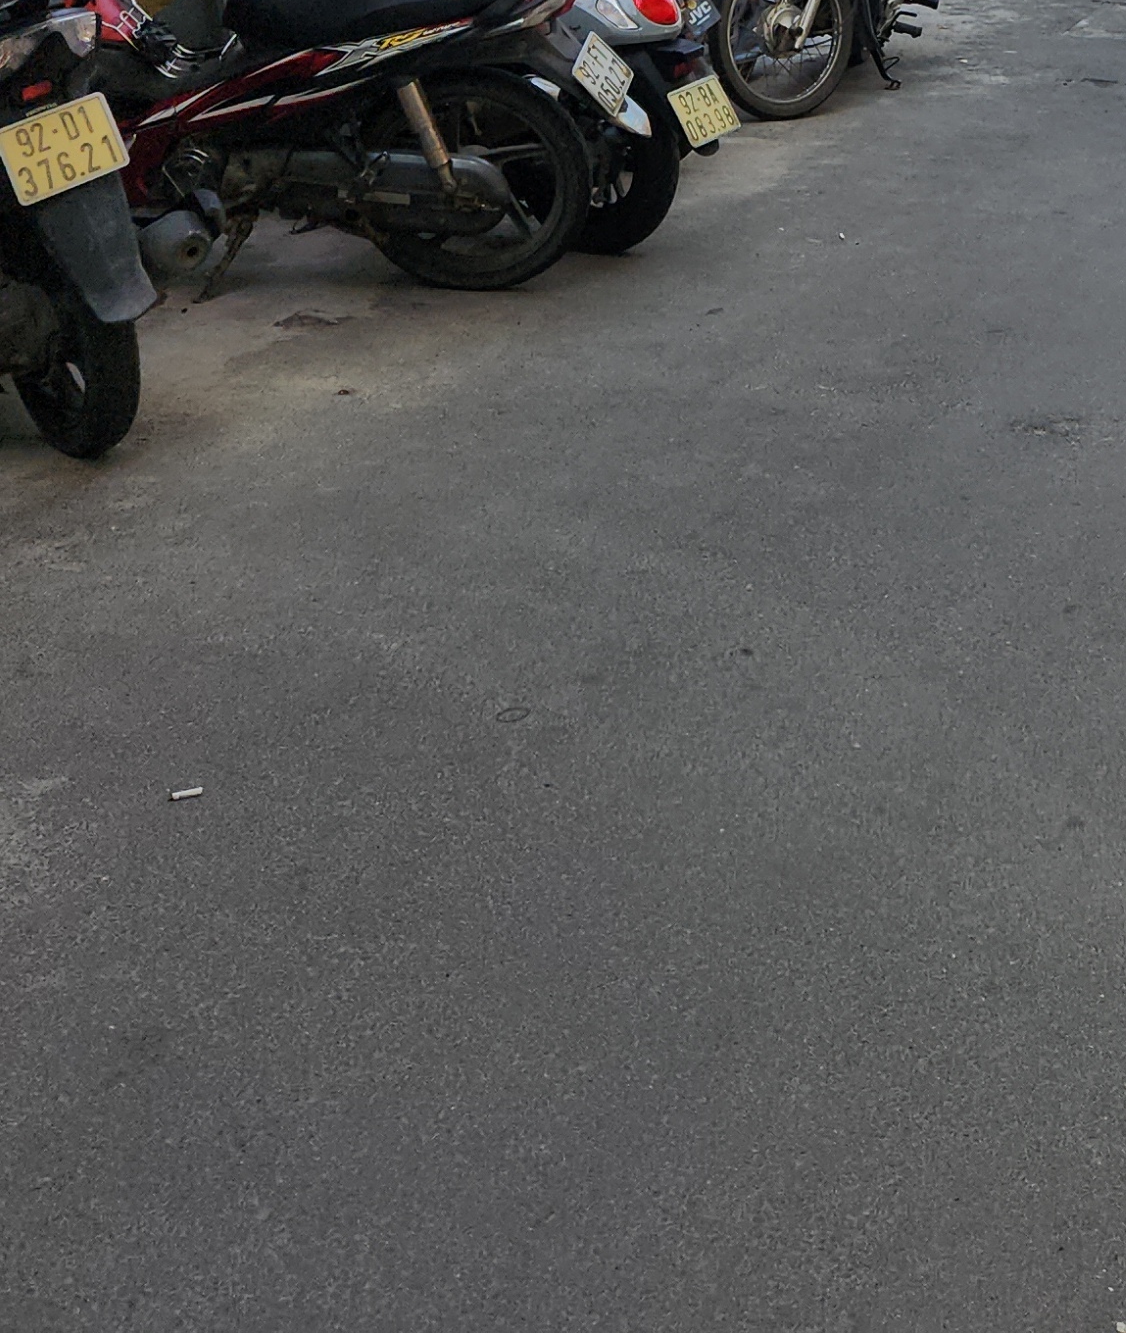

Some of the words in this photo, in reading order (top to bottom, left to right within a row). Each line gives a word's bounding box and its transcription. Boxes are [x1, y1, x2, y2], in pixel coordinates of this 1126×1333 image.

[688, 0, 712, 25] JVC
[678, 83, 720, 116] 92-BA
[685, 105, 735, 142] 083.98
[18, 135, 118, 197] 376.21
